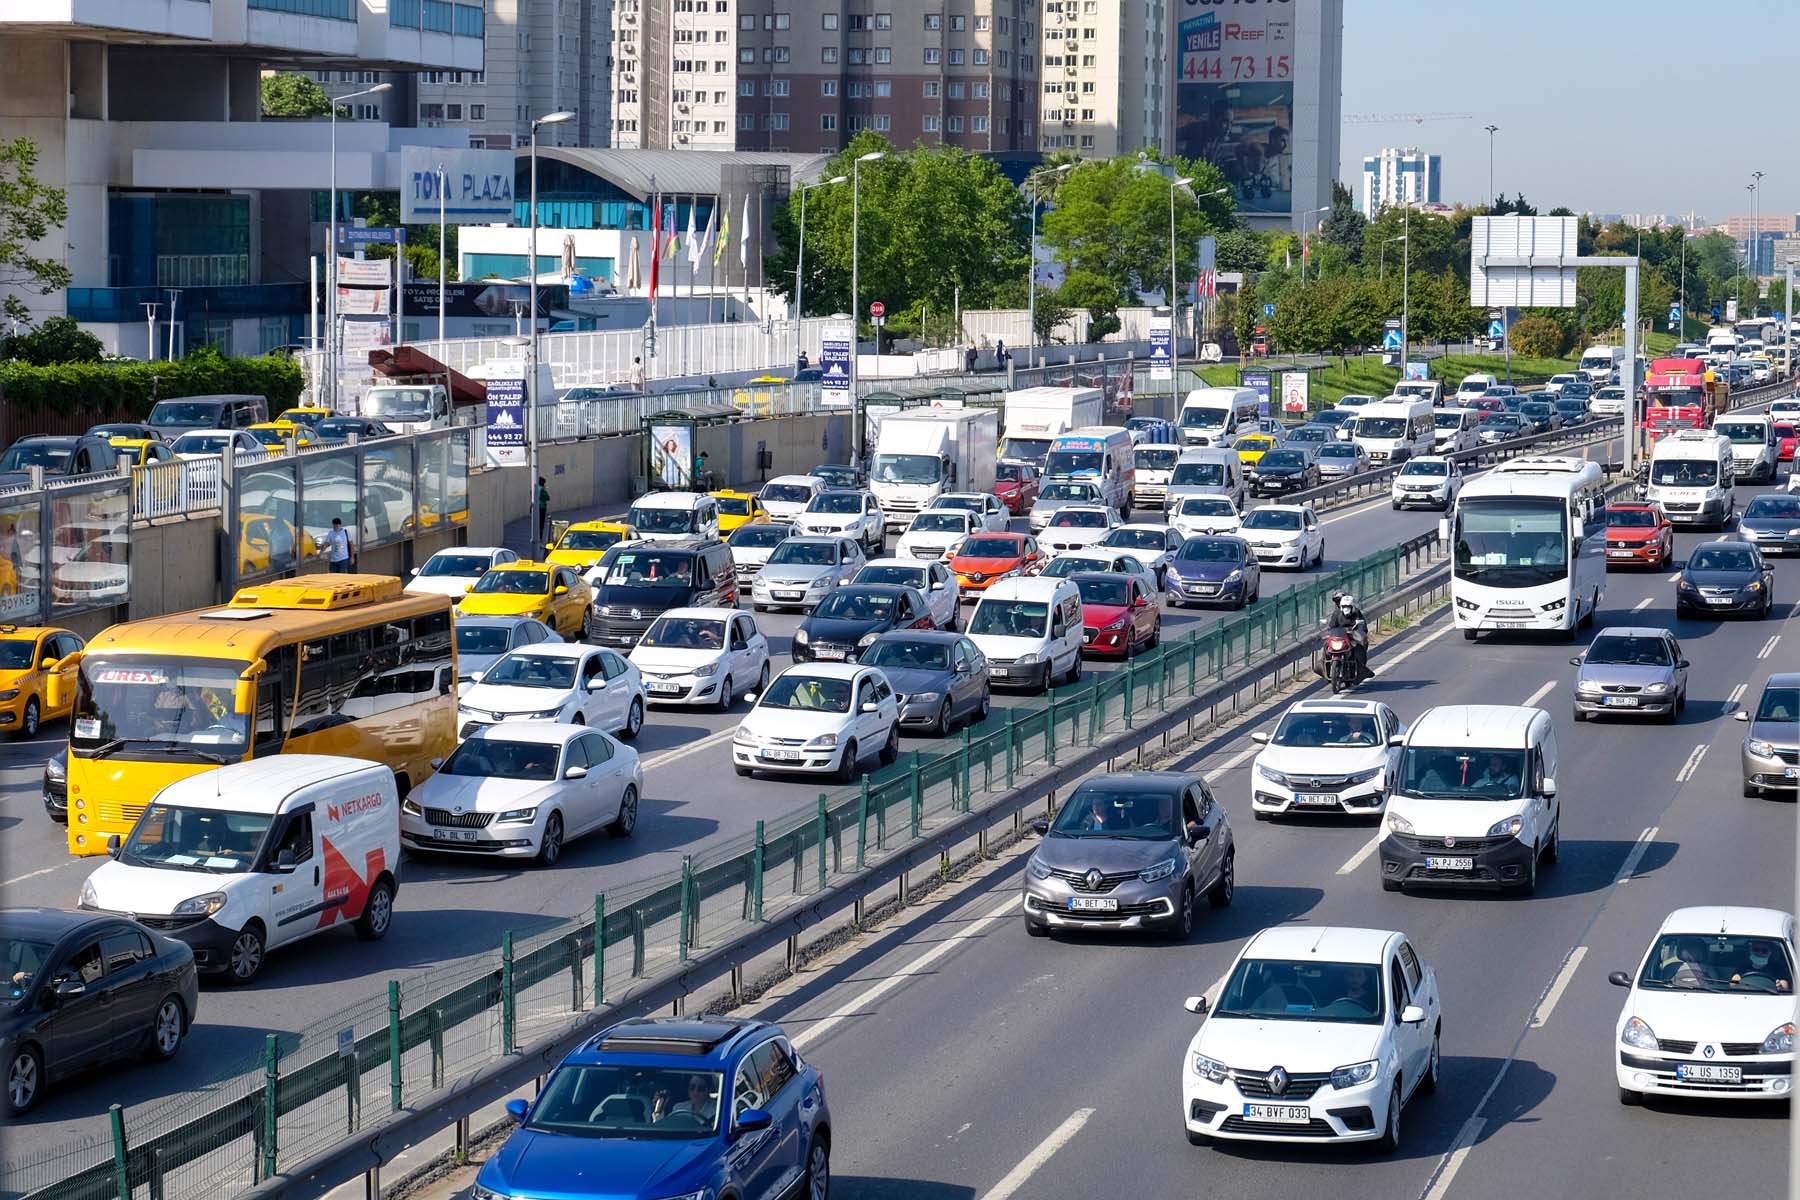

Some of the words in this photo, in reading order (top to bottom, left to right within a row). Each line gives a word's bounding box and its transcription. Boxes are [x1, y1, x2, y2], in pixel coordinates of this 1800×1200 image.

[1183, 56, 1223, 80] 444
[1231, 55, 1256, 80] 73
[1265, 55, 1290, 80] 15
[413, 171, 452, 201] TOYA
[462, 173, 512, 201] PLAZA
[426, 287, 465, 296] PROELERİ
[341, 792, 382, 817] NETKARGO
[1431, 858, 1439, 866] 34
[1455, 859, 1472, 867] 2556
[1073, 899, 1082, 907] 34
[1085, 899, 1098, 907] BET
[1103, 899, 1116, 908] 314
[1683, 1066, 1694, 1076] 34
[1700, 1067, 1712, 1078] US
[1719, 1068, 1740, 1079] 1359
[1250, 1106, 1262, 1116] 34
[1266, 1107, 1285, 1118] BVF
[1288, 1107, 1307, 1119] 033
